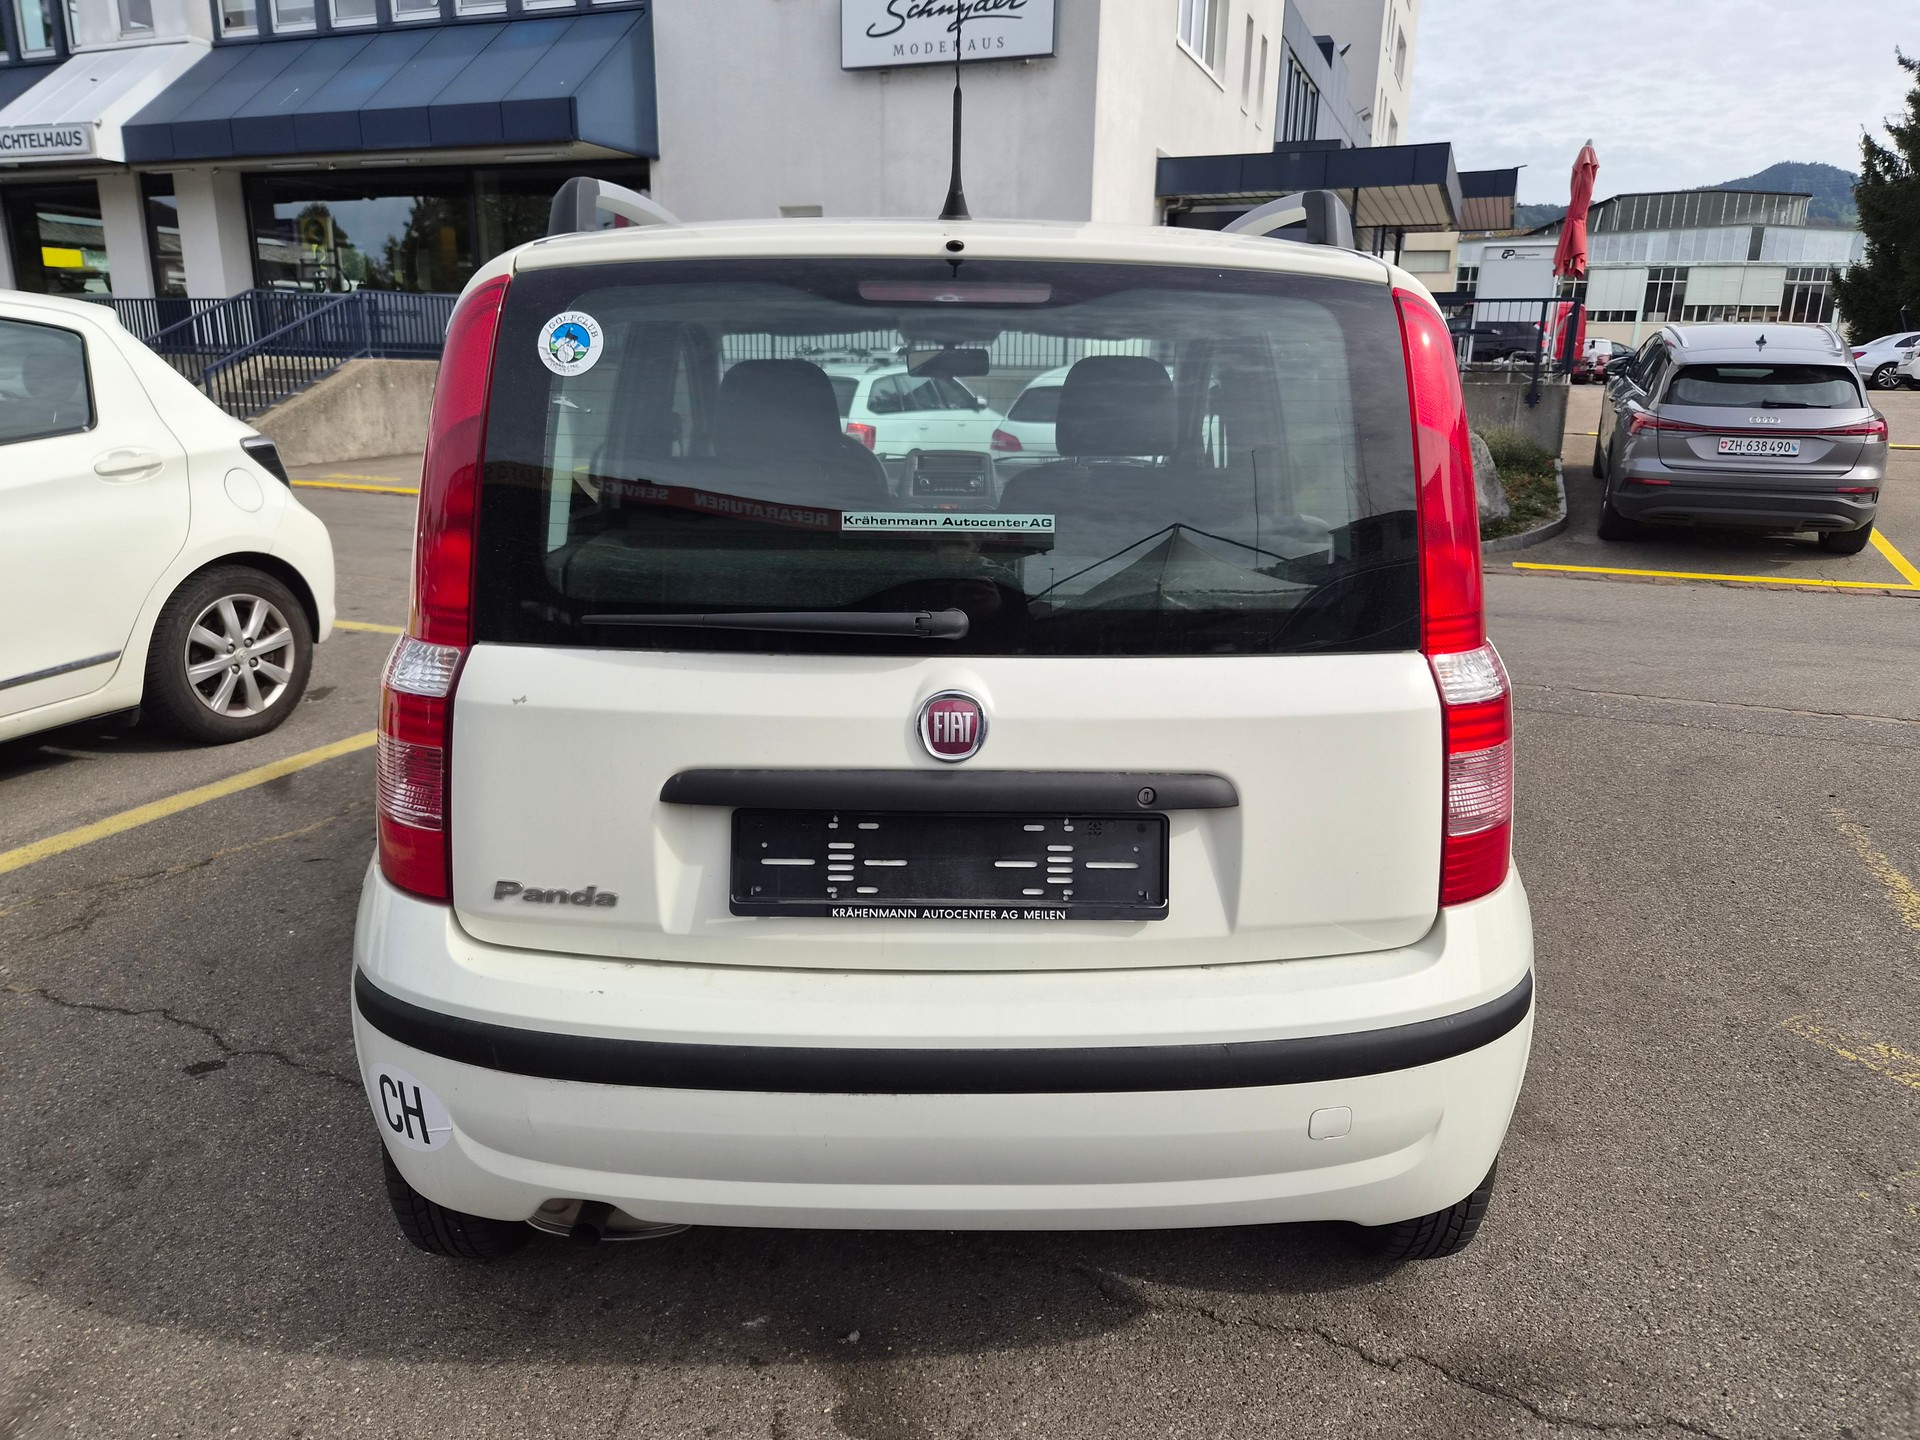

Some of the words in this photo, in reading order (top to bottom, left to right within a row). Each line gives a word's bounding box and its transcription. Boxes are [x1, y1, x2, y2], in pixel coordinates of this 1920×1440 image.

[548, 314, 599, 338] GOLFCLUB
[843, 515, 938, 527] Krähenmann
[942, 517, 1028, 528] Autocenter
[1029, 518, 1053, 528] AG
[933, 711, 974, 743] FIAT
[493, 880, 619, 907] Panda
[832, 906, 917, 918] KRÄHENMANN
[922, 908, 997, 919] AUTOCENTER
[1000, 909, 1019, 920] AG
[1023, 910, 1067, 920] MEILEN
[379, 1073, 431, 1145] CH
